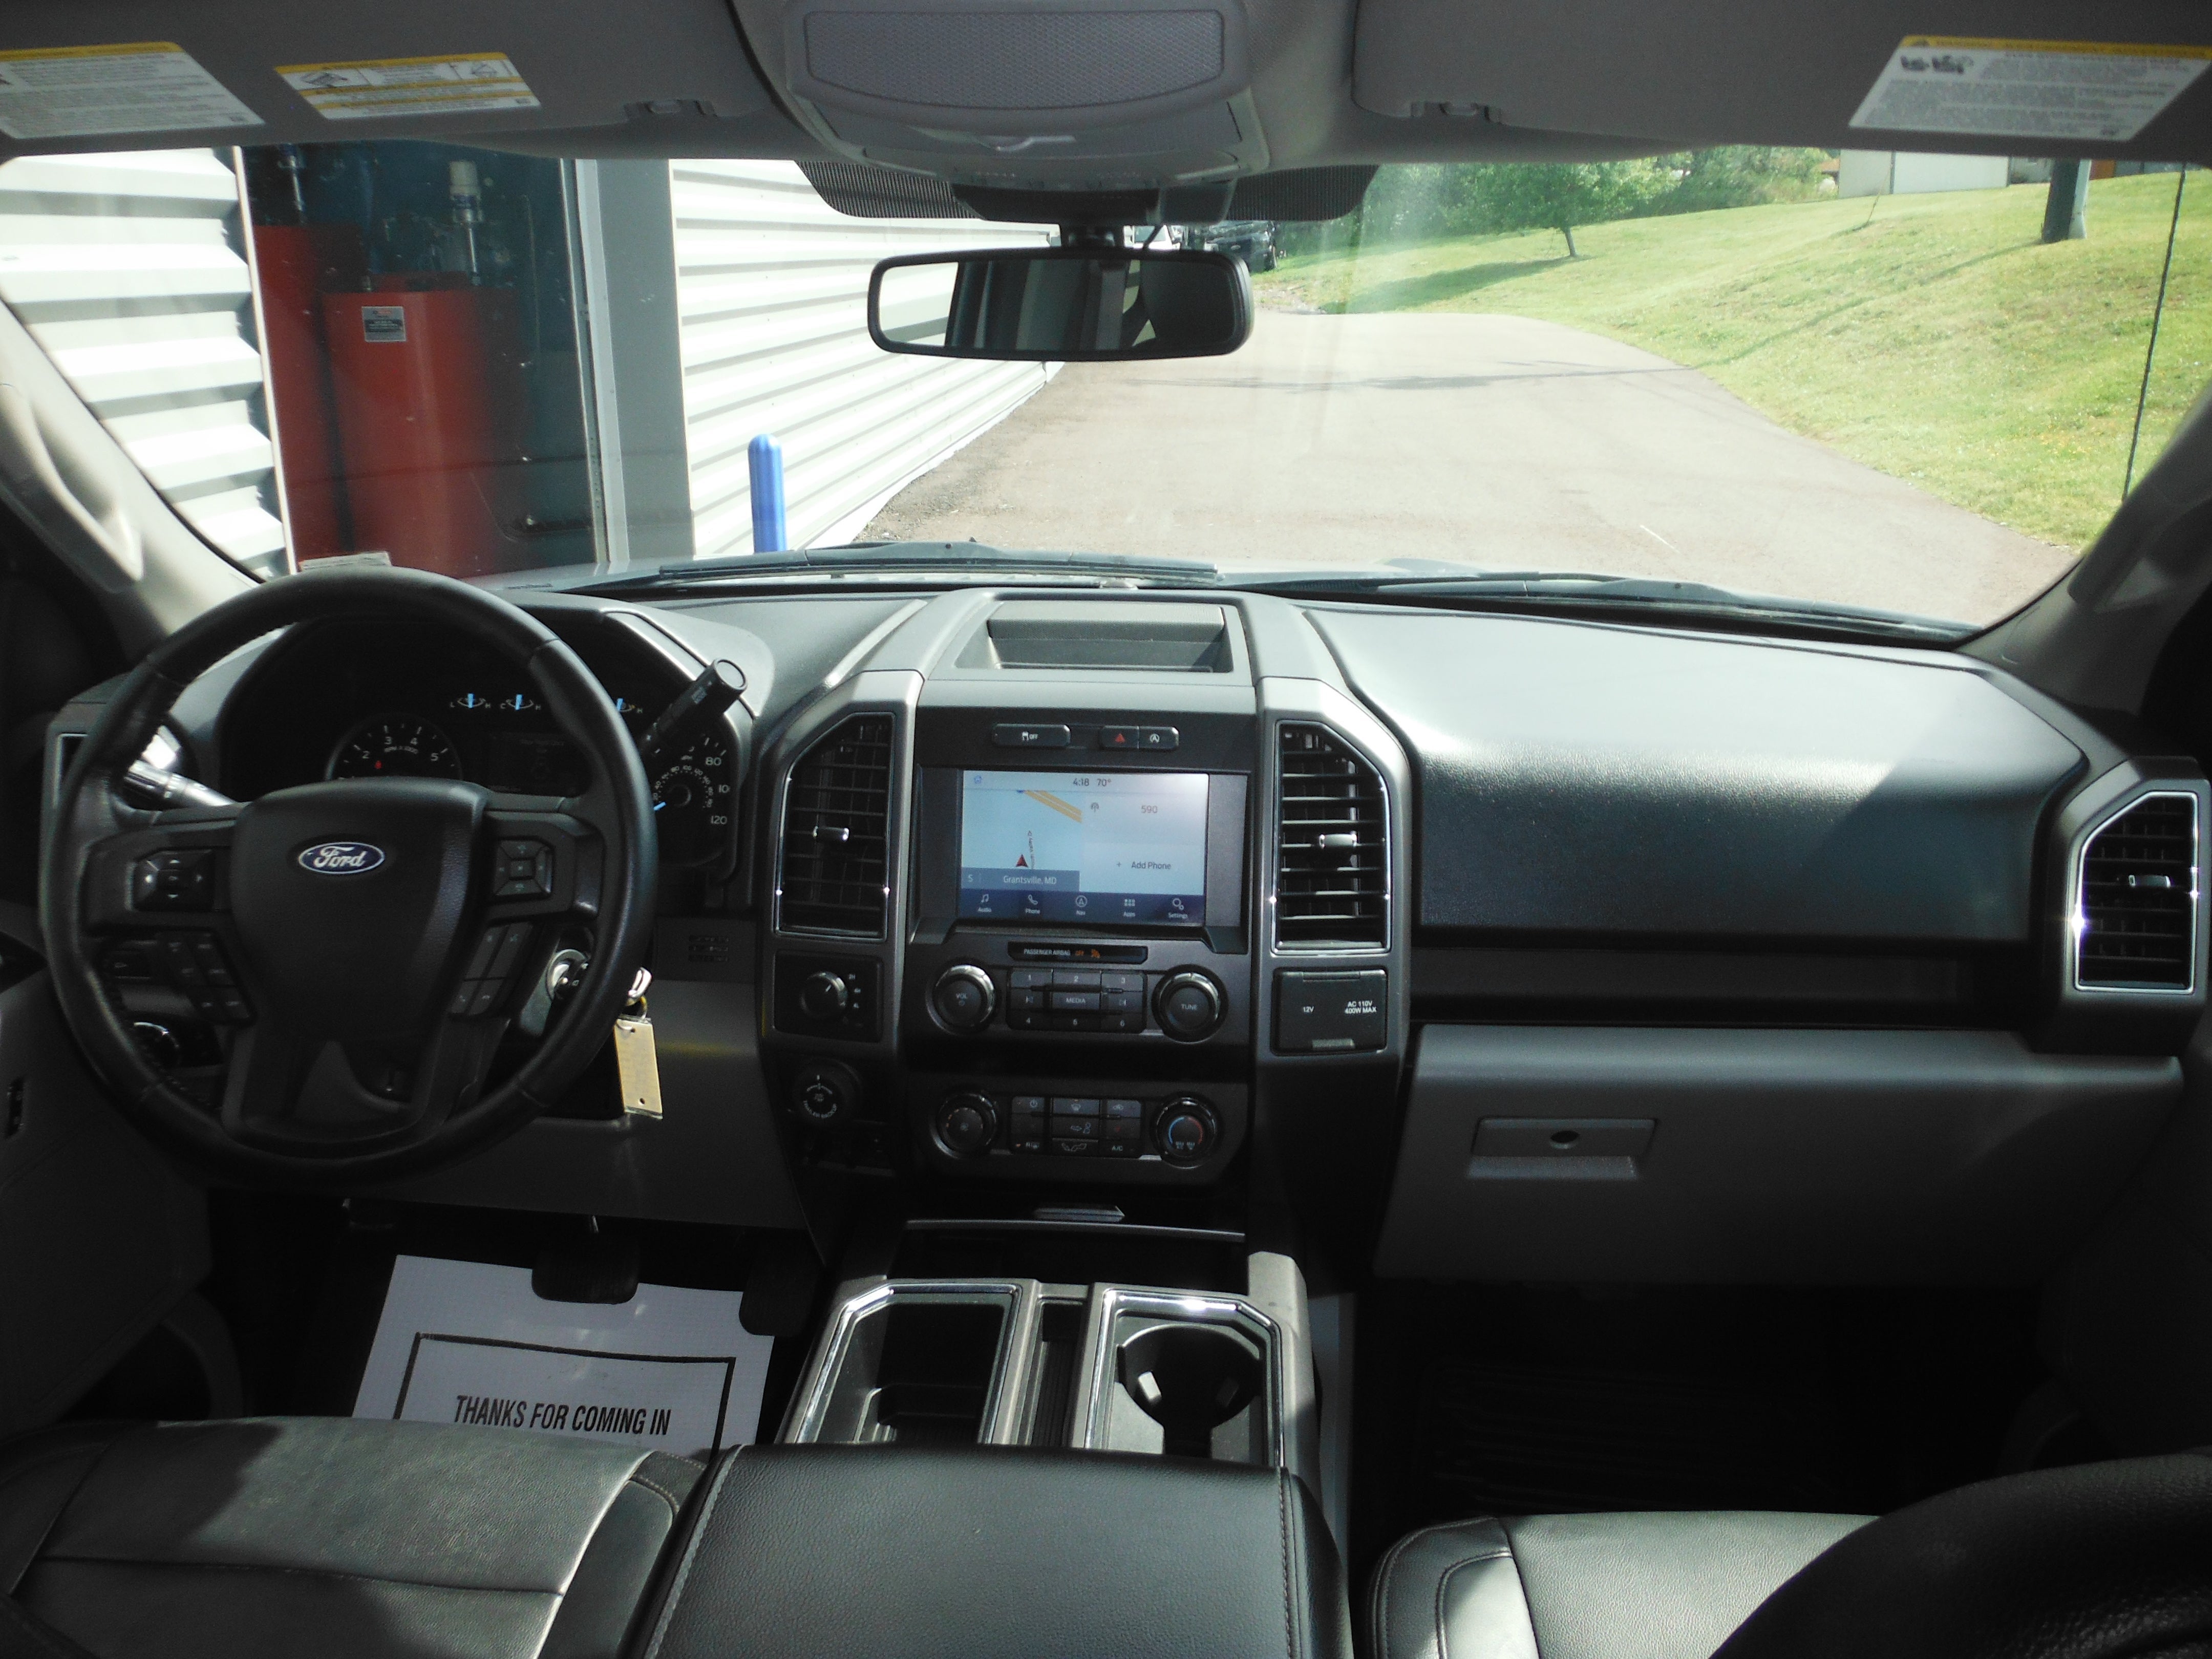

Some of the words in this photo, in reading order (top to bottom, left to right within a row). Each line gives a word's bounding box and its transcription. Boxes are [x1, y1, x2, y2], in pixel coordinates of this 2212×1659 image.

[385, 736, 393, 745] 3
[361, 751, 370, 759] 2
[430, 752, 439, 761] 5
[706, 757, 722, 766] 80
[1097, 778, 1111, 786] 70°
[1141, 805, 1158, 814] 590
[711, 816, 728, 824] 120
[313, 845, 368, 868] Ford
[1131, 861, 1146, 869] Add
[1147, 861, 1172, 869] Phone
[1003, 876, 1043, 885] Grantsville,
[1045, 877, 1057, 885] MD
[454, 1395, 527, 1428] THANKS
[529, 1403, 569, 1430] FOR
[571, 1405, 647, 1435] COMING
[649, 1409, 671, 1436] IN
